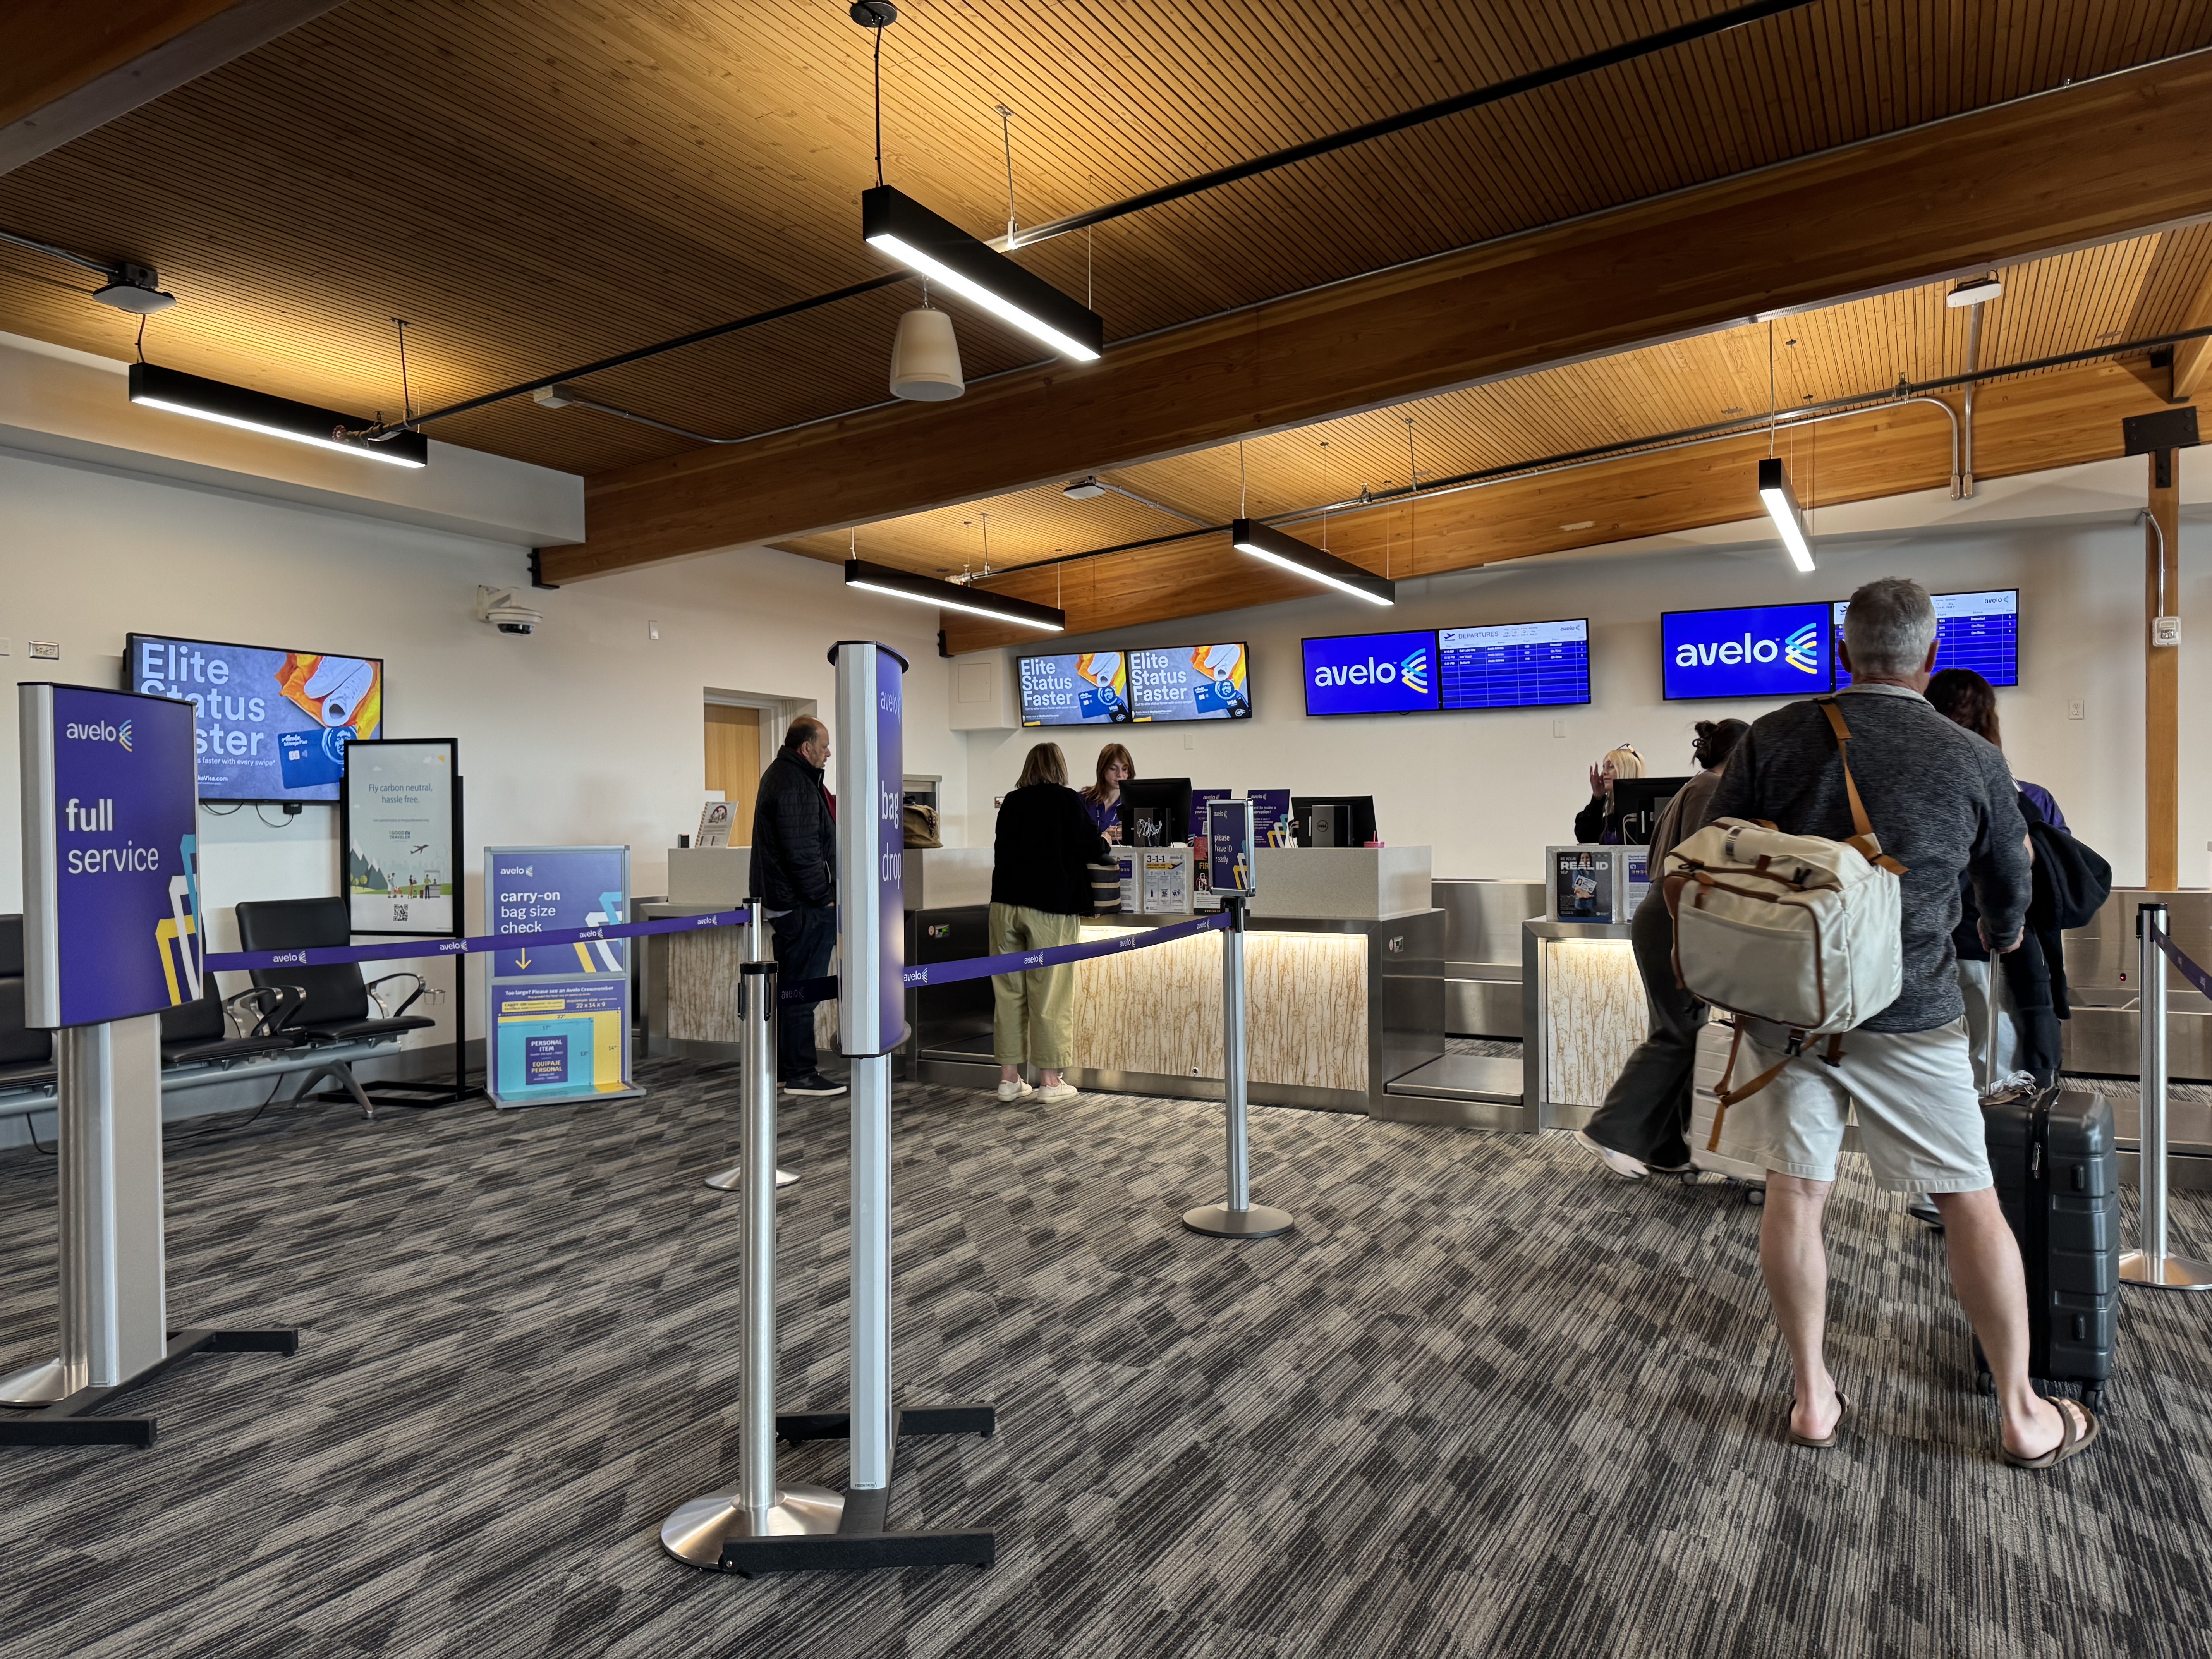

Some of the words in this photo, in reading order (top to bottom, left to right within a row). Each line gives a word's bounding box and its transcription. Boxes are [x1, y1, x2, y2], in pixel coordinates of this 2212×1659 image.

[1676, 633, 1778, 667] avelo
[142, 643, 229, 685] Elite
[1021, 659, 1056, 675] Elite
[1130, 652, 1168, 669] Elite
[1132, 669, 1187, 685] Status
[1315, 657, 1396, 687] avelo
[1022, 675, 1072, 690] Status
[1024, 691, 1073, 706] Faster
[1133, 685, 1187, 702] Faster
[881, 689, 897, 714] avelo
[66, 720, 116, 742] avelo
[196, 723, 264, 756] ster
[369, 783, 378, 793] Fly
[380, 783, 404, 792] carbon
[406, 783, 433, 792] neutral,
[404, 795, 419, 803] free.
[882, 780, 899, 830] bag
[66, 799, 113, 831] full
[1214, 833, 1230, 843] please
[68, 840, 159, 874] service
[1216, 855, 1228, 864] ready
[500, 866, 524, 875] avelo
[882, 842, 902, 889] drop
[1560, 861, 1595, 870] REAL
[1595, 861, 1608, 870] ID
[501, 891, 560, 903] carry-on
[501, 906, 526, 919] bag
[530, 905, 556, 917] size
[501, 921, 543, 934] check
[1197, 920, 1207, 929] avelo
[580, 930, 597, 938] avelo
[440, 941, 460, 951] avelo
[1120, 938, 1131, 947] avelo
[273, 953, 297, 963] avelo
[1024, 953, 1038, 965] avelo
[903, 971, 921, 982] avelo
[781, 987, 798, 1000] avelo
